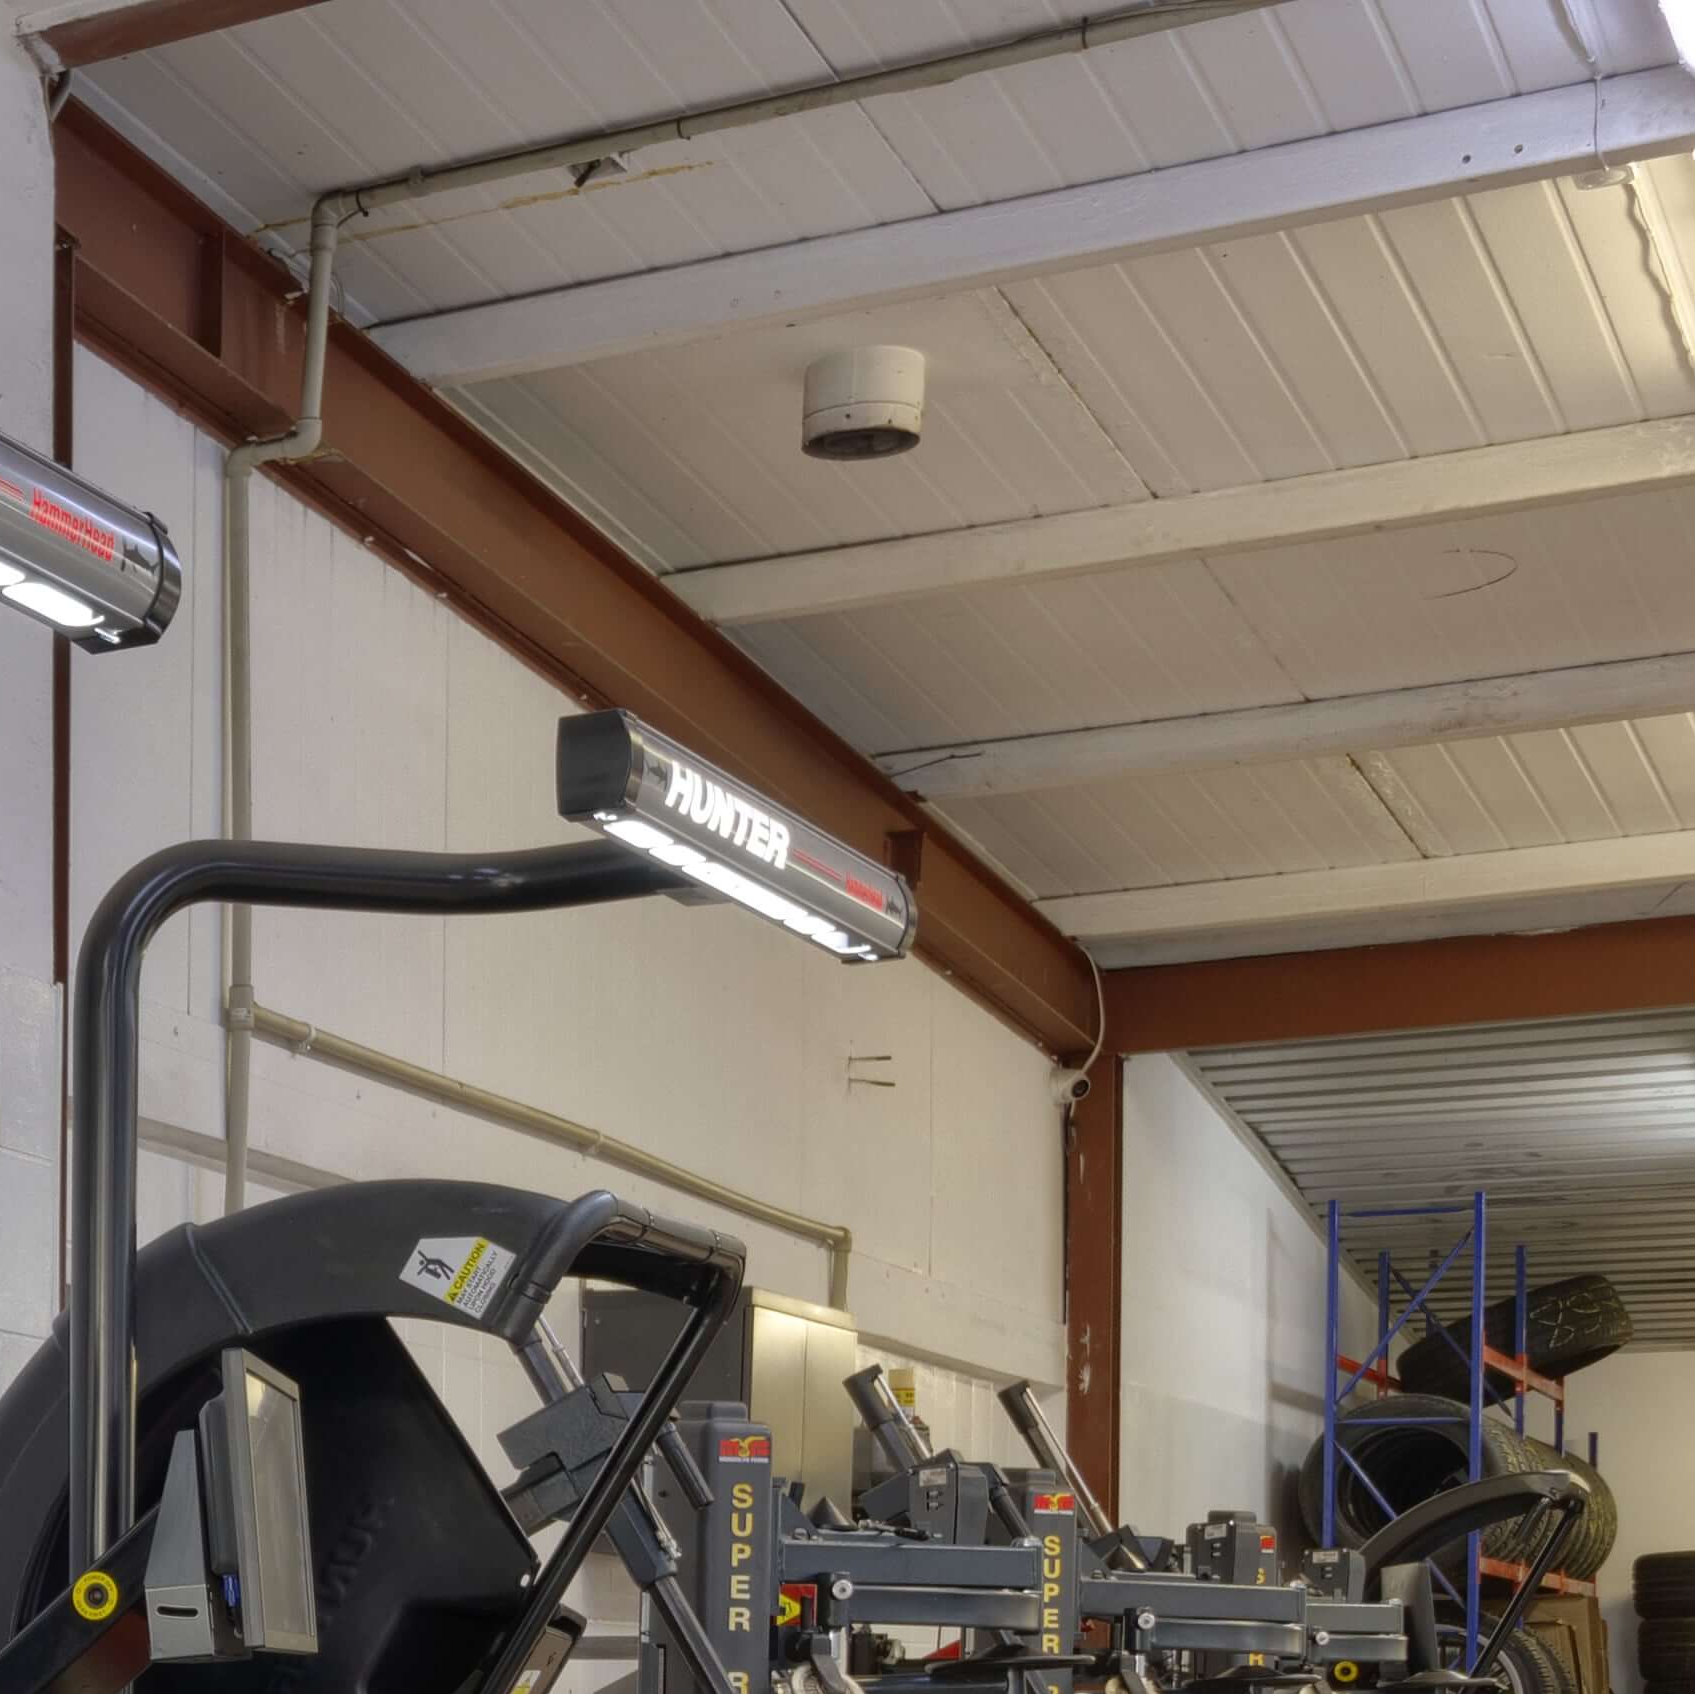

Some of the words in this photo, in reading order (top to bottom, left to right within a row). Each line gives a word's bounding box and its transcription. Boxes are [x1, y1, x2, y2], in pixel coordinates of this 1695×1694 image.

[30, 487, 114, 561] HammerHead
[665, 759, 791, 870] HUNTER
[453, 1242, 485, 1290] CAUTION
[728, 1482, 754, 1633] SUPER
[1042, 1535, 1061, 1655] SUPER
